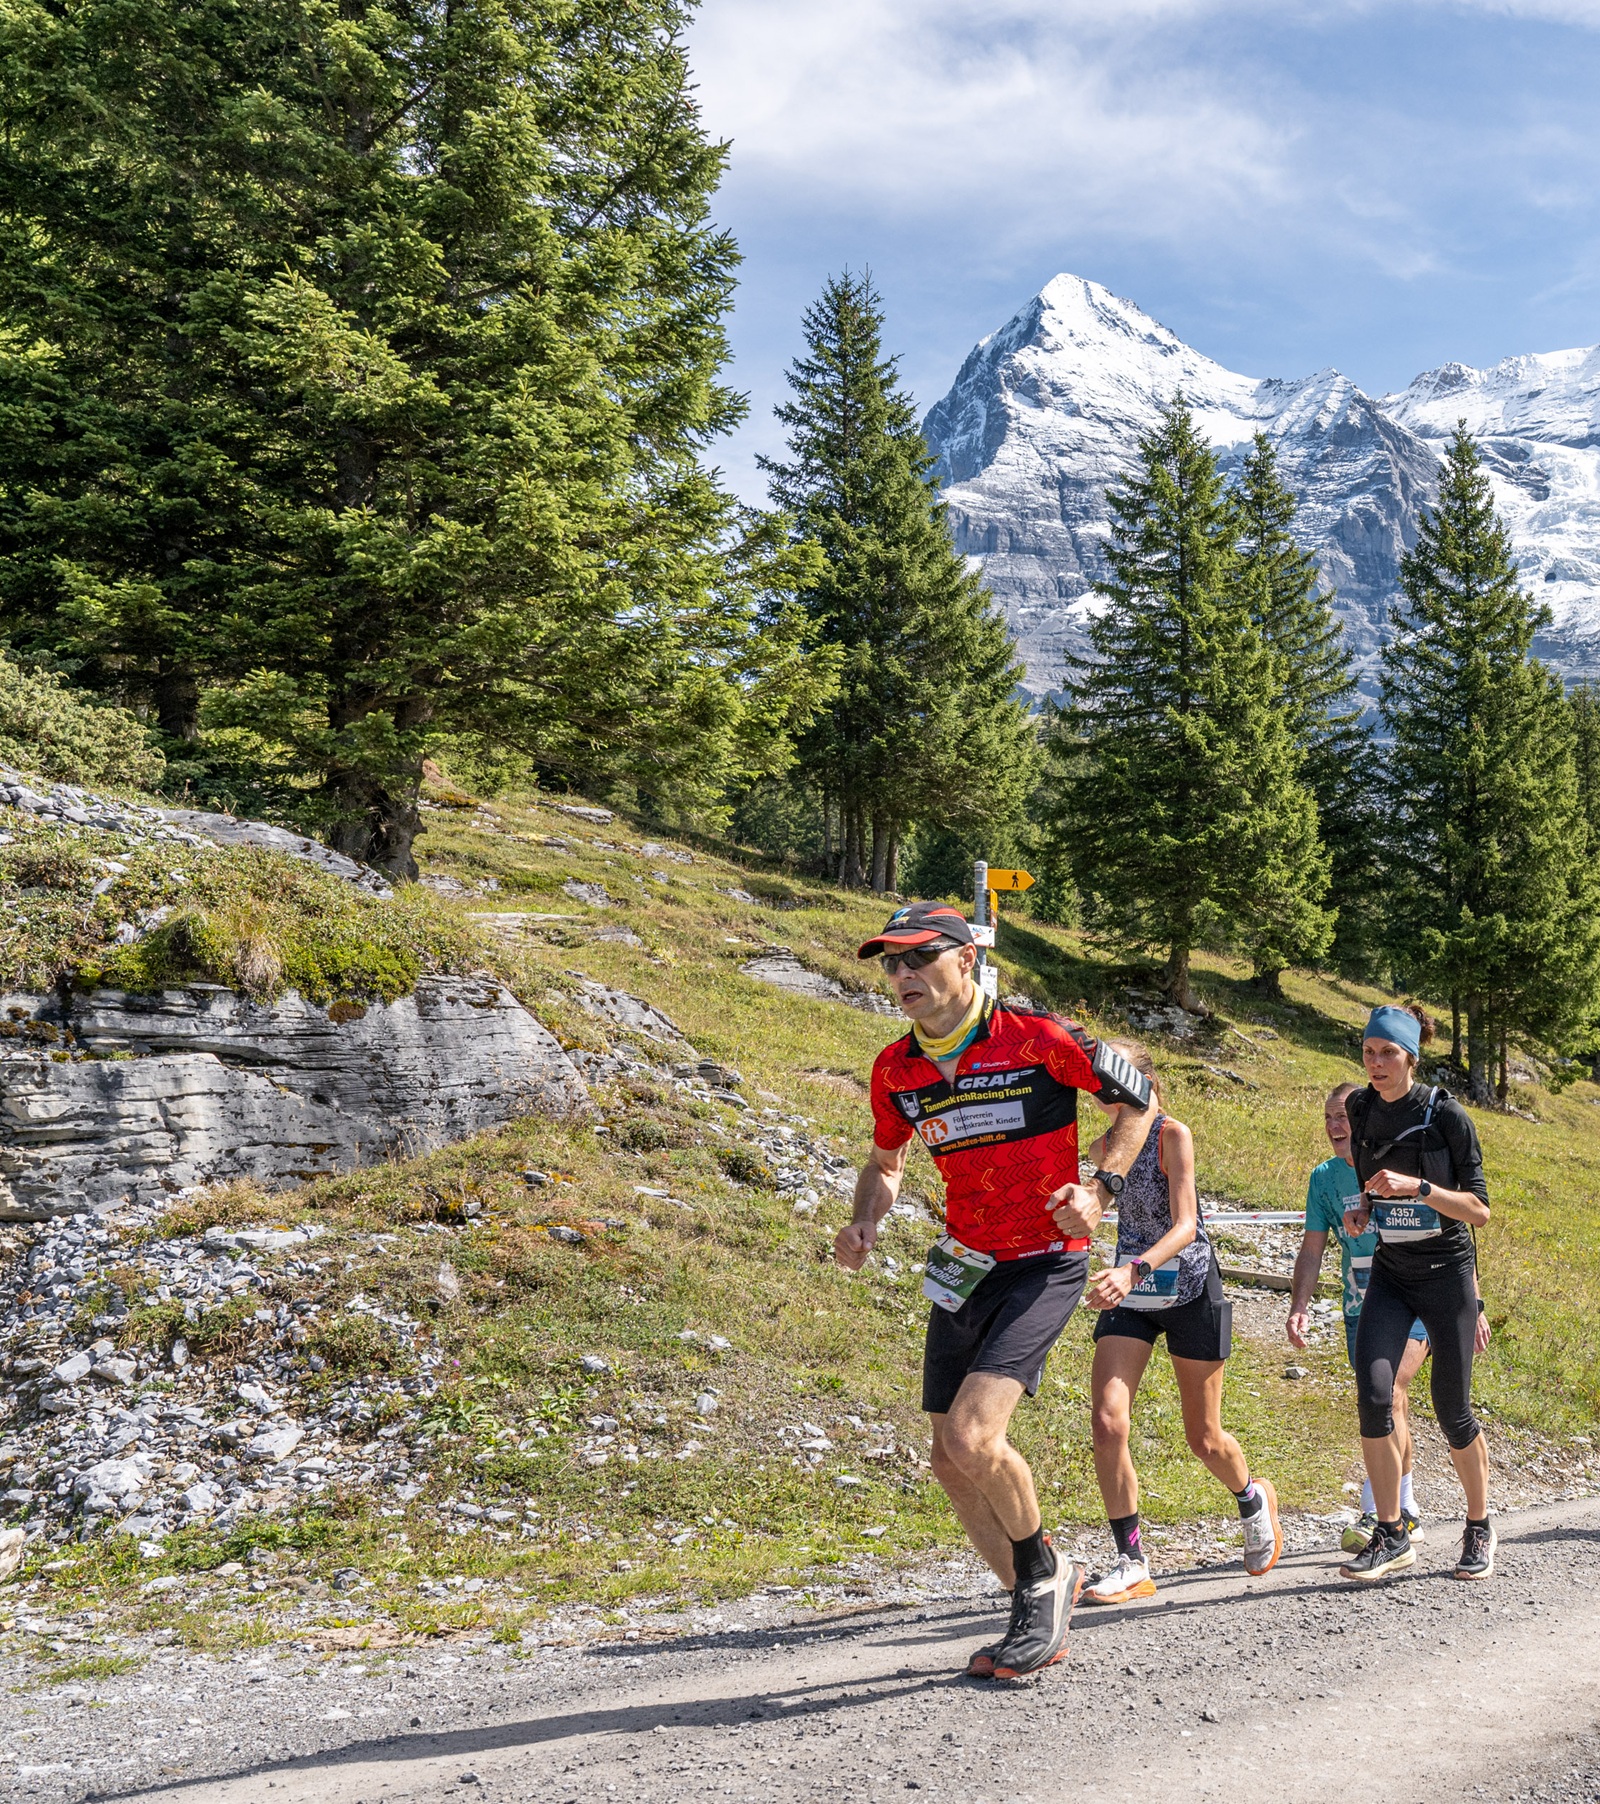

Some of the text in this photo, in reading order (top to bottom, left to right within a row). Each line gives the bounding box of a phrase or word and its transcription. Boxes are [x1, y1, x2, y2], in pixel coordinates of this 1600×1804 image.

[957, 1072, 1020, 1090] GRAF
[952, 1111, 993, 1124] Föderverein
[996, 1116, 1021, 1125] Kinder
[1390, 1207, 1415, 1217] 4357
[1385, 1217, 1421, 1227] SIMONE
[926, 1261, 964, 1287] ANDREAS
[943, 1261, 965, 1276] 308
[1131, 1282, 1157, 1293] AURA
